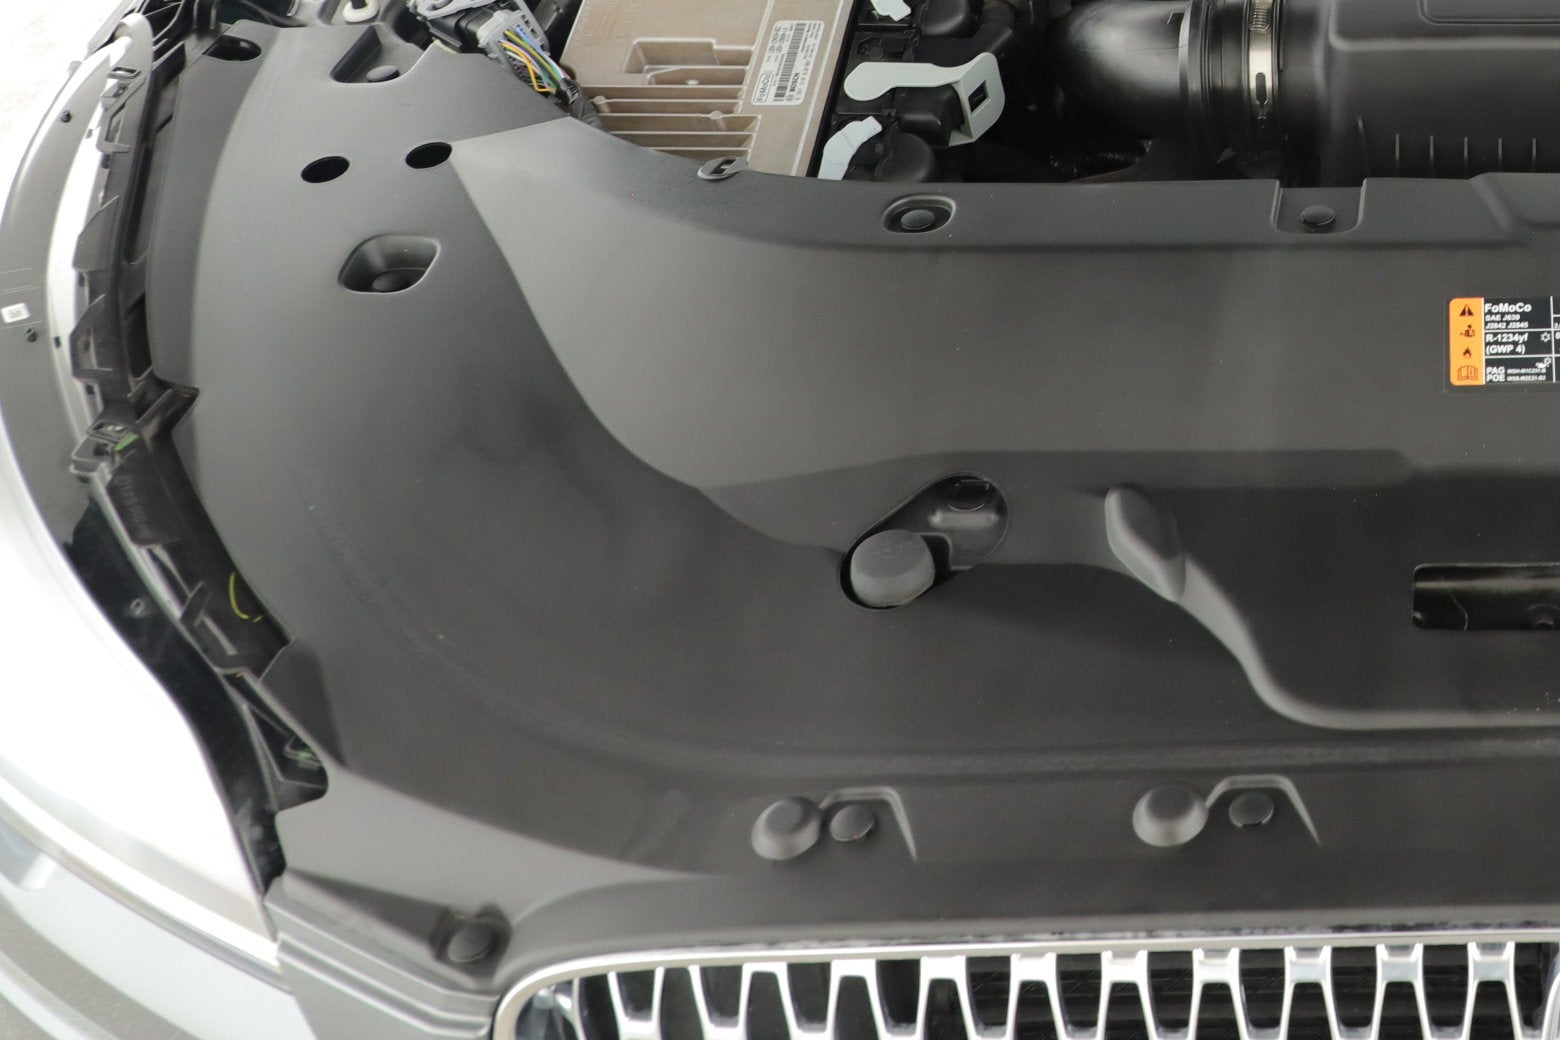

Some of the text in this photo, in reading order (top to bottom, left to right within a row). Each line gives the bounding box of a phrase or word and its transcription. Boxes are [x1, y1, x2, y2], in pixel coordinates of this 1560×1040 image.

[756, 75, 770, 102] FoMoCo
[1484, 302, 1532, 313] FoMoCo
[1486, 333, 1529, 344] R-1234yf
[1486, 344, 1525, 355] (GWP 4)
